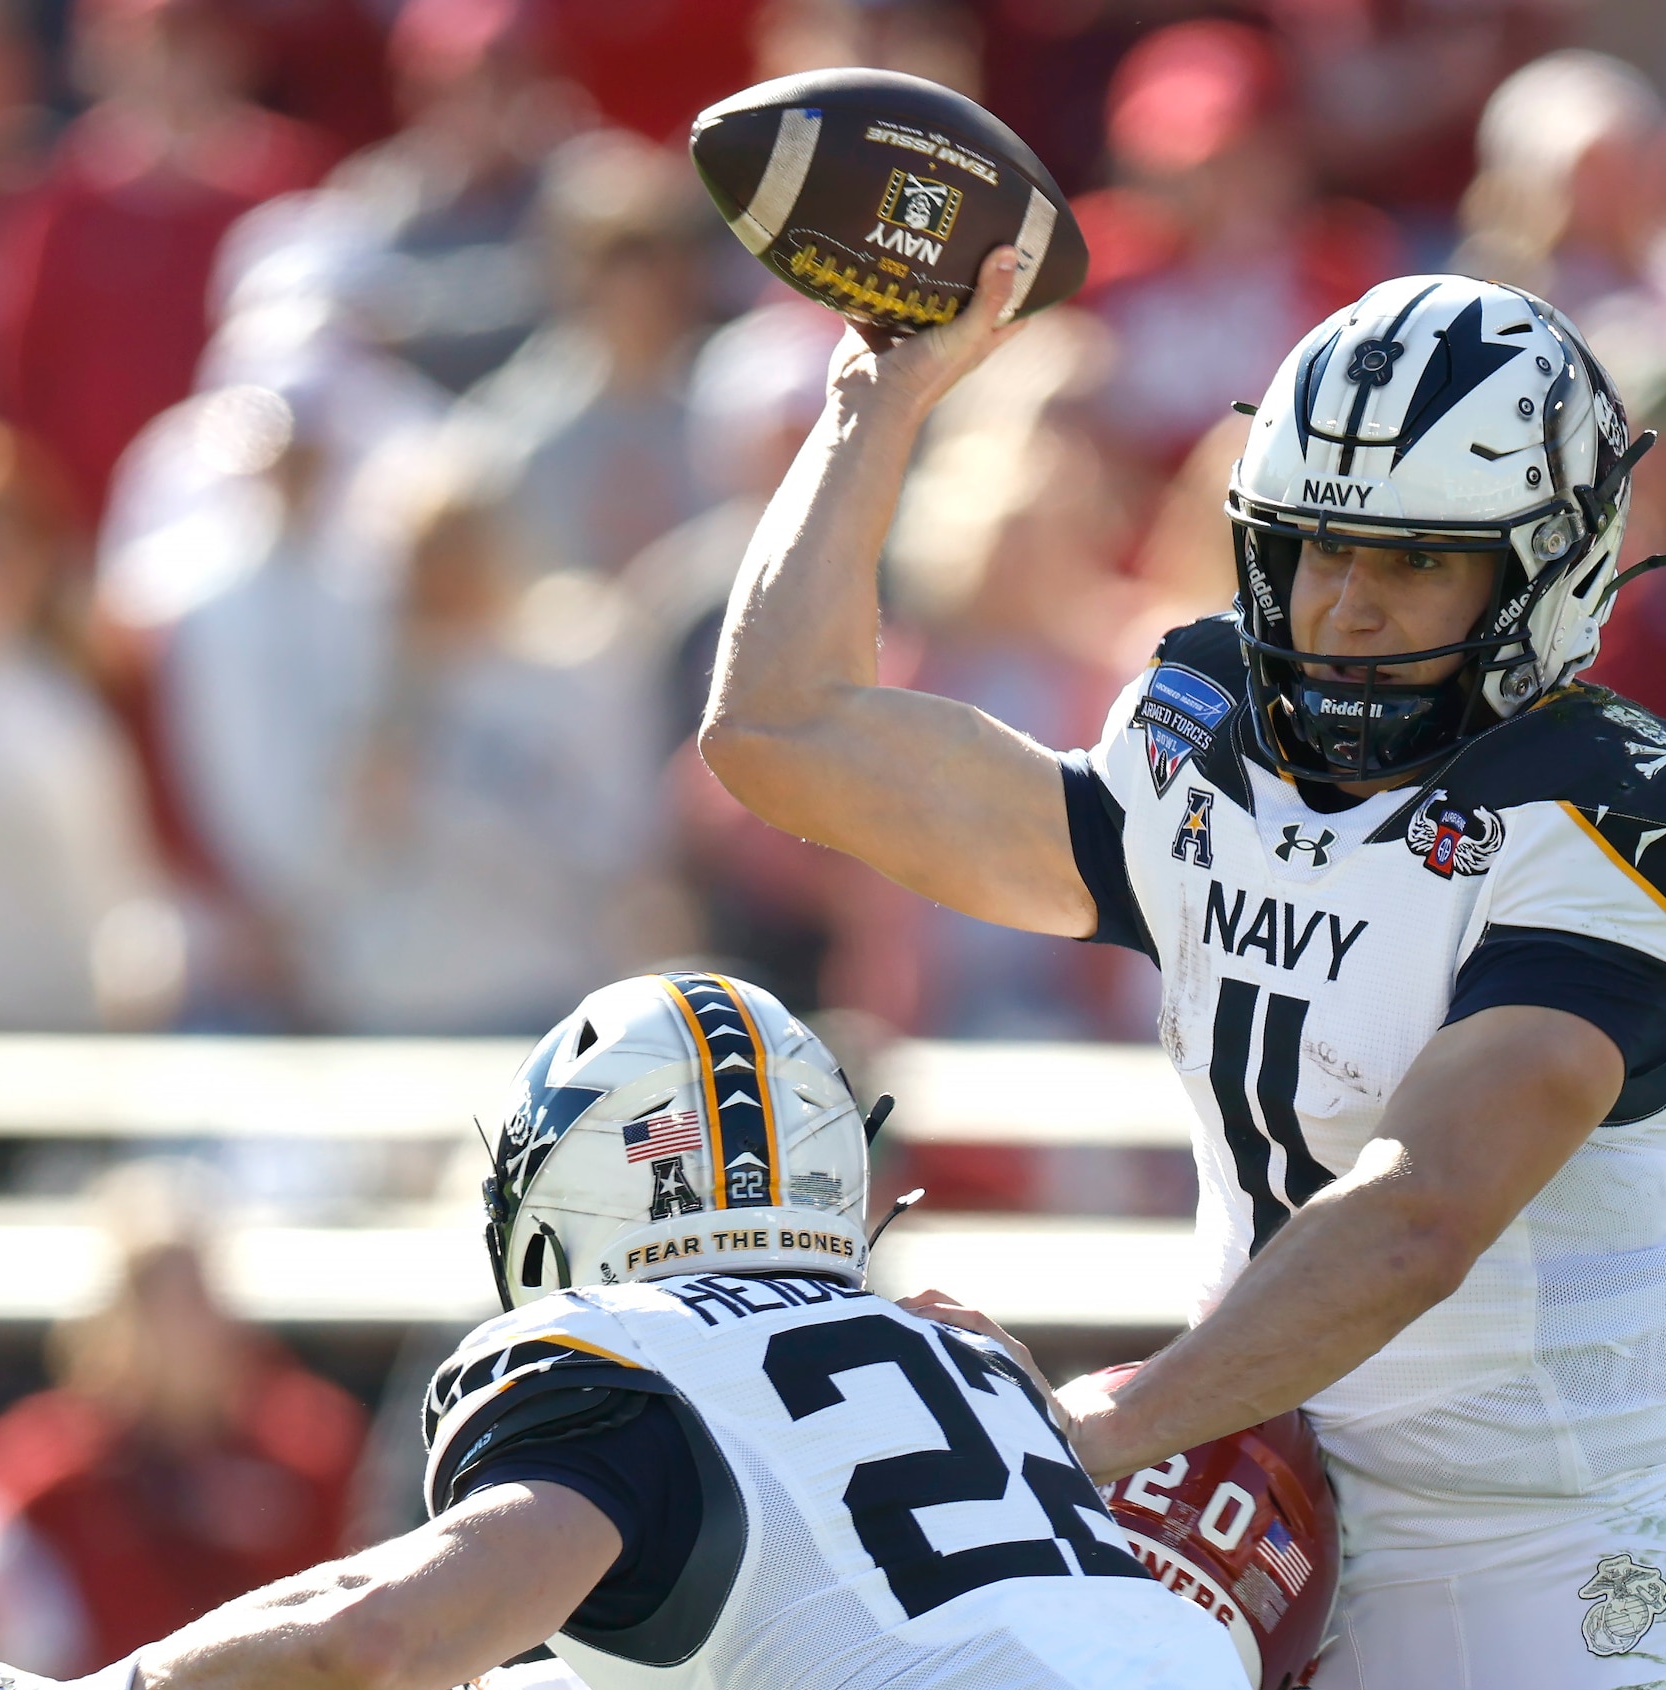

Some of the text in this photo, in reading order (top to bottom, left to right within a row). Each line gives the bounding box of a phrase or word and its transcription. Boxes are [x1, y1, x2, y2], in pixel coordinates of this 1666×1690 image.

[864, 125, 936, 157] ISSUE
[934, 146, 1000, 186] TEAM
[865, 222, 943, 266] NAVY
[1303, 478, 1374, 509] NAVY
[1245, 545, 1284, 623] Riddell
[1141, 701, 1214, 751] ARMED FORCES
[1155, 729, 1178, 752] BOWL
[1202, 879, 1369, 982] NAVY
[1209, 977, 1337, 1259] 11
[732, 1171, 764, 1199] 22
[625, 1229, 855, 1272] FEAR THE BONES
[763, 1314, 1161, 1621] 22
[1123, 1453, 1257, 1551] 20
[1127, 1540, 1235, 1630] NERS
